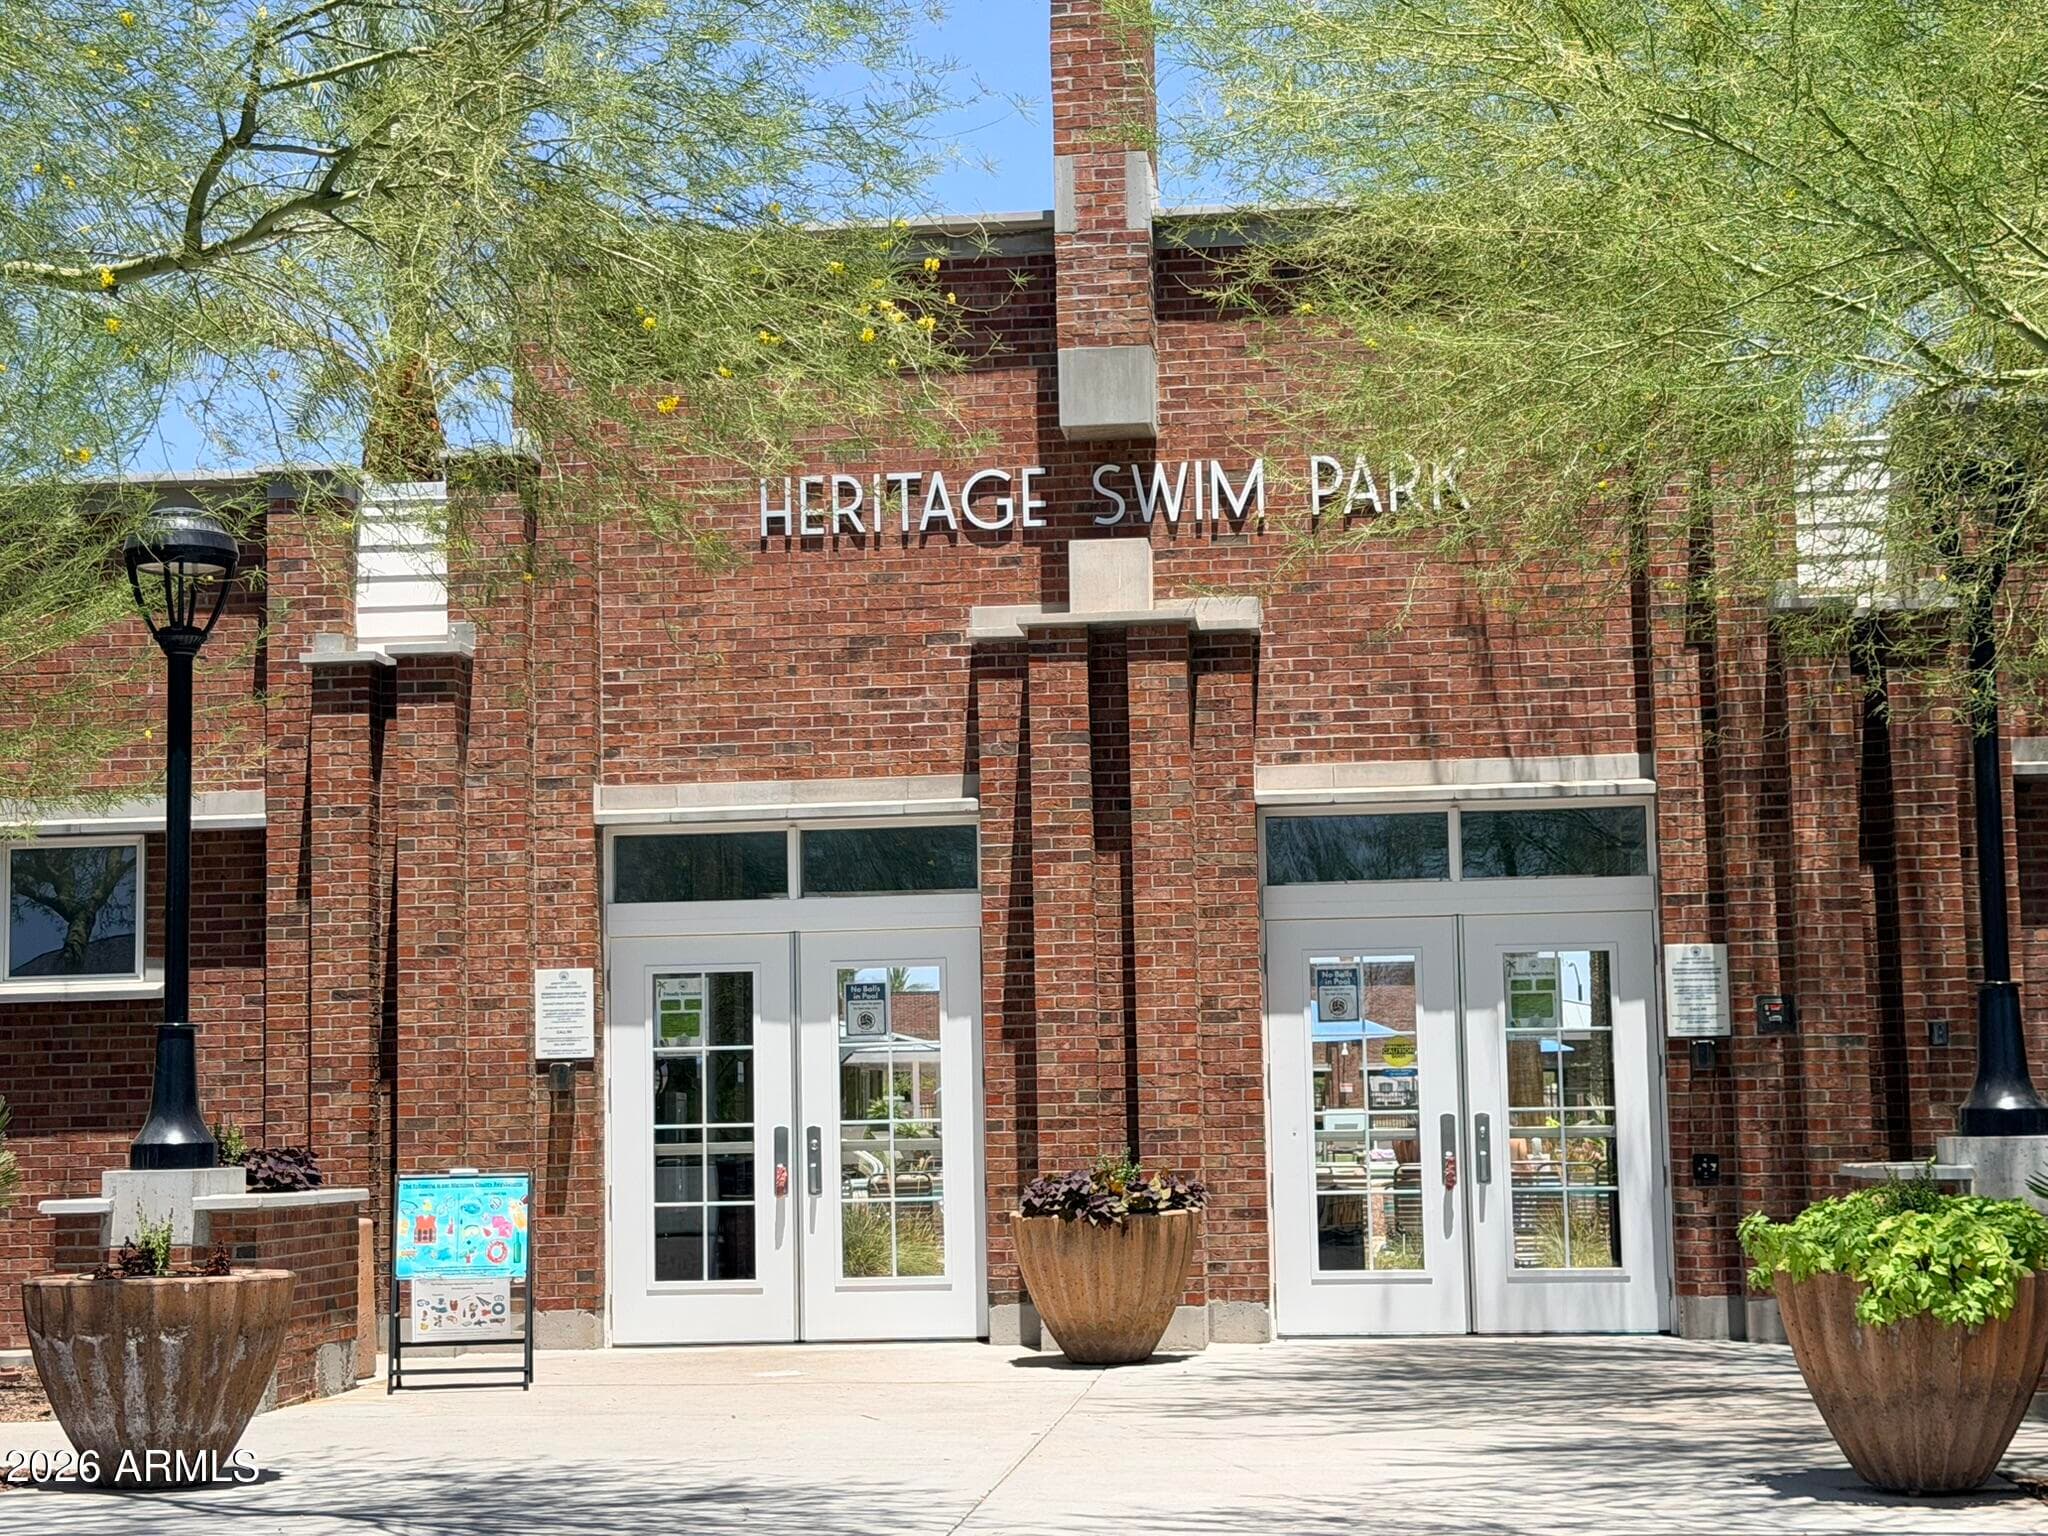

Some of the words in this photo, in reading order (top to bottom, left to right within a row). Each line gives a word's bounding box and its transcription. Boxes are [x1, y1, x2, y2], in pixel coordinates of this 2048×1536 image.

[760, 468, 1047, 537] HERITAGE
[1093, 458, 1266, 526] SWIM
[1311, 447, 1471, 515] PARK
[1333, 977, 1351, 985] Pool
[850, 985, 862, 993] No
[862, 984, 881, 993] Balls
[853, 992, 861, 1000] in
[862, 992, 879, 1000] Pool
[1382, 1047, 1415, 1055] CAUTION
